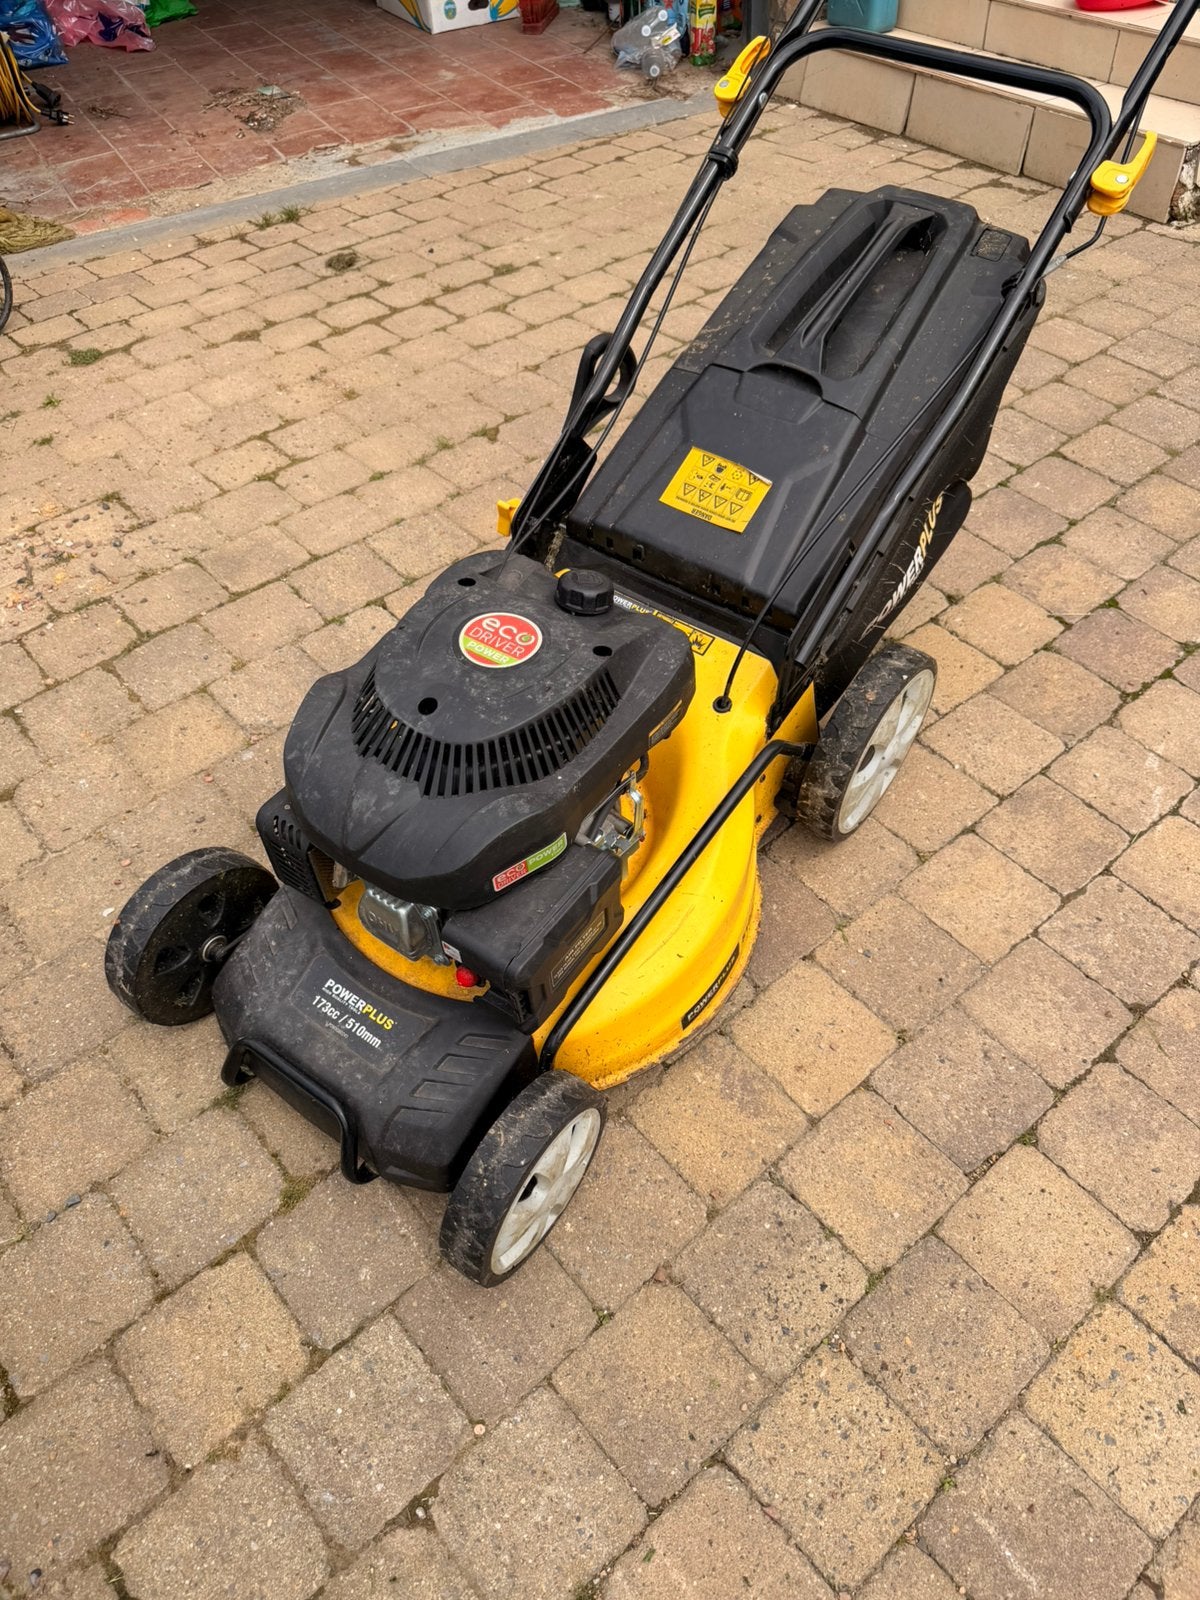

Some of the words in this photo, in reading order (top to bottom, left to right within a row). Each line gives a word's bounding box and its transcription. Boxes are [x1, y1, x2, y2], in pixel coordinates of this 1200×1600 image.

[691, 507, 713, 521] DANGER
[469, 626, 526, 657] DRIVER
[481, 617, 536, 646] eco
[466, 641, 510, 664] POWER
[528, 839, 564, 865] POWER
[496, 863, 526, 882] eco
[497, 868, 528, 889] DRIVER
[687, 956, 736, 1021] POWERPLUS
[324, 978, 395, 1030] POWERPLUS
[312, 995, 341, 1020] 173cc
[338, 1014, 348, 1024] /
[345, 1018, 382, 1049] 510mm
